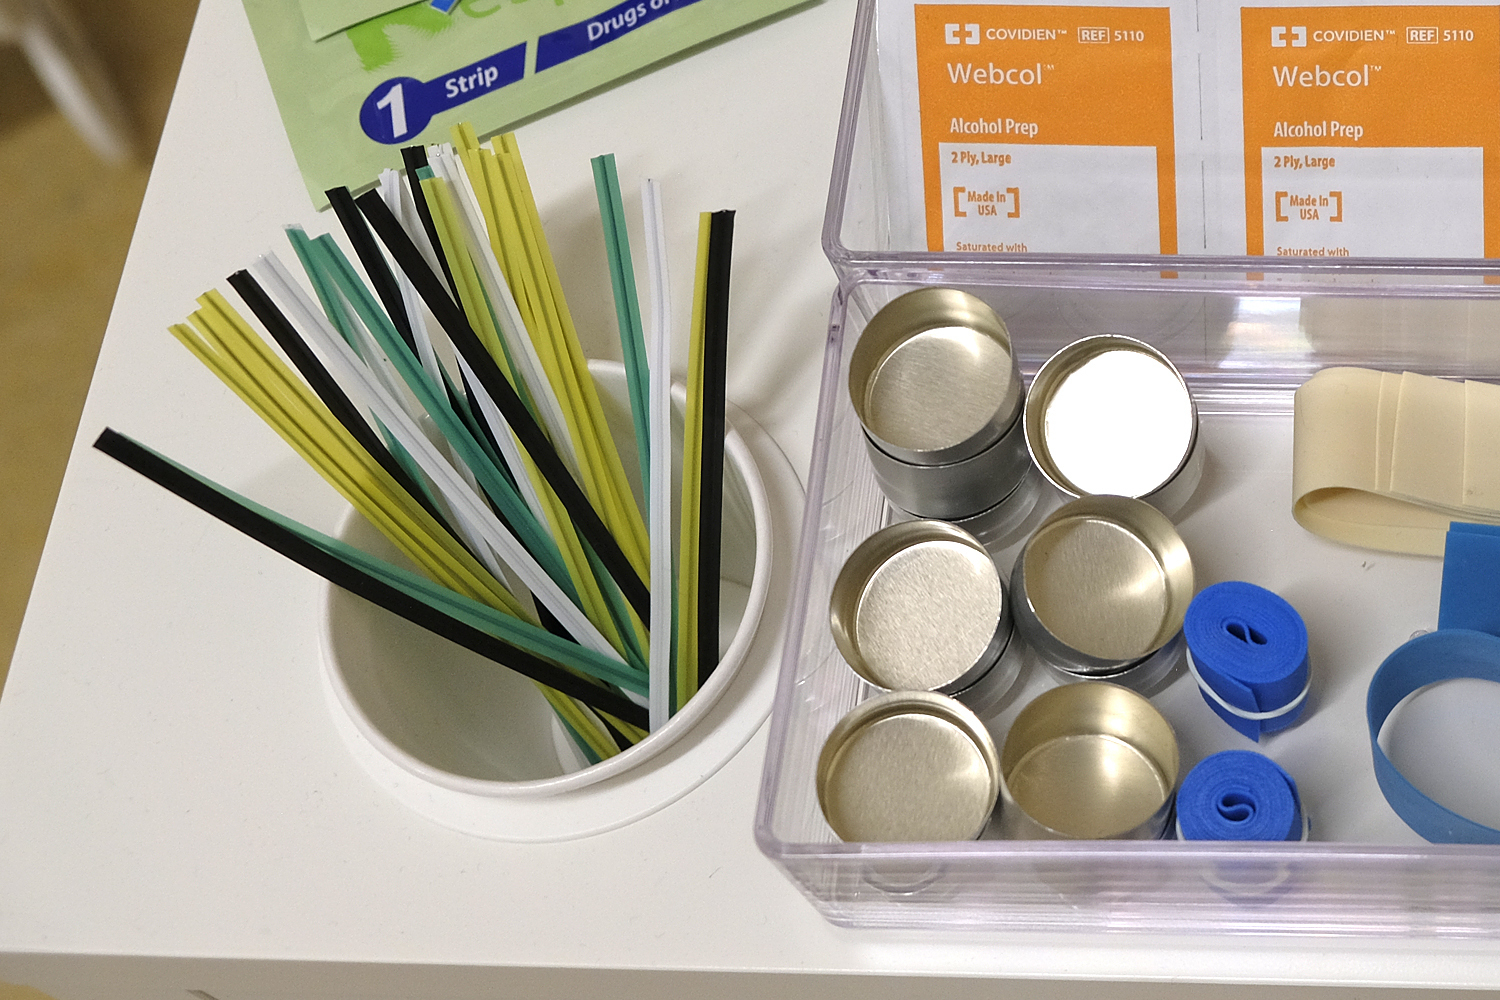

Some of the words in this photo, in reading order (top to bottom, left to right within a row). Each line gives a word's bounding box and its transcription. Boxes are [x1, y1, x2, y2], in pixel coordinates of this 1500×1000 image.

[587, 2, 648, 41] Drugs
[1081, 28, 1106, 42] REF
[1114, 29, 1144, 43] 5110
[1409, 28, 1436, 43] REF
[1443, 29, 1474, 43] 5110
[376, 82, 408, 138] 1
[445, 65, 499, 98] Strip
[949, 117, 1002, 136] Alcohol
[1006, 119, 1039, 138] Prep
[1273, 121, 1327, 138] Alcohol
[1331, 122, 1364, 142] Prep
[951, 151, 957, 164] 2
[960, 151, 979, 167] Ply,
[981, 152, 1011, 167] Large
[1273, 155, 1280, 168] 2
[1283, 155, 1302, 170] Ply,
[1305, 155, 1335, 171] Large
[967, 190, 991, 203] Made
[993, 191, 1007, 203] In
[1289, 195, 1315, 207] Made
[1317, 195, 1329, 207] In
[978, 204, 997, 216] USA
[1300, 208, 1320, 221] USA
[956, 240, 1003, 252] Saturated
[1006, 241, 1028, 253] with
[1276, 245, 1327, 257] Saturated
[1329, 245, 1350, 257] with
